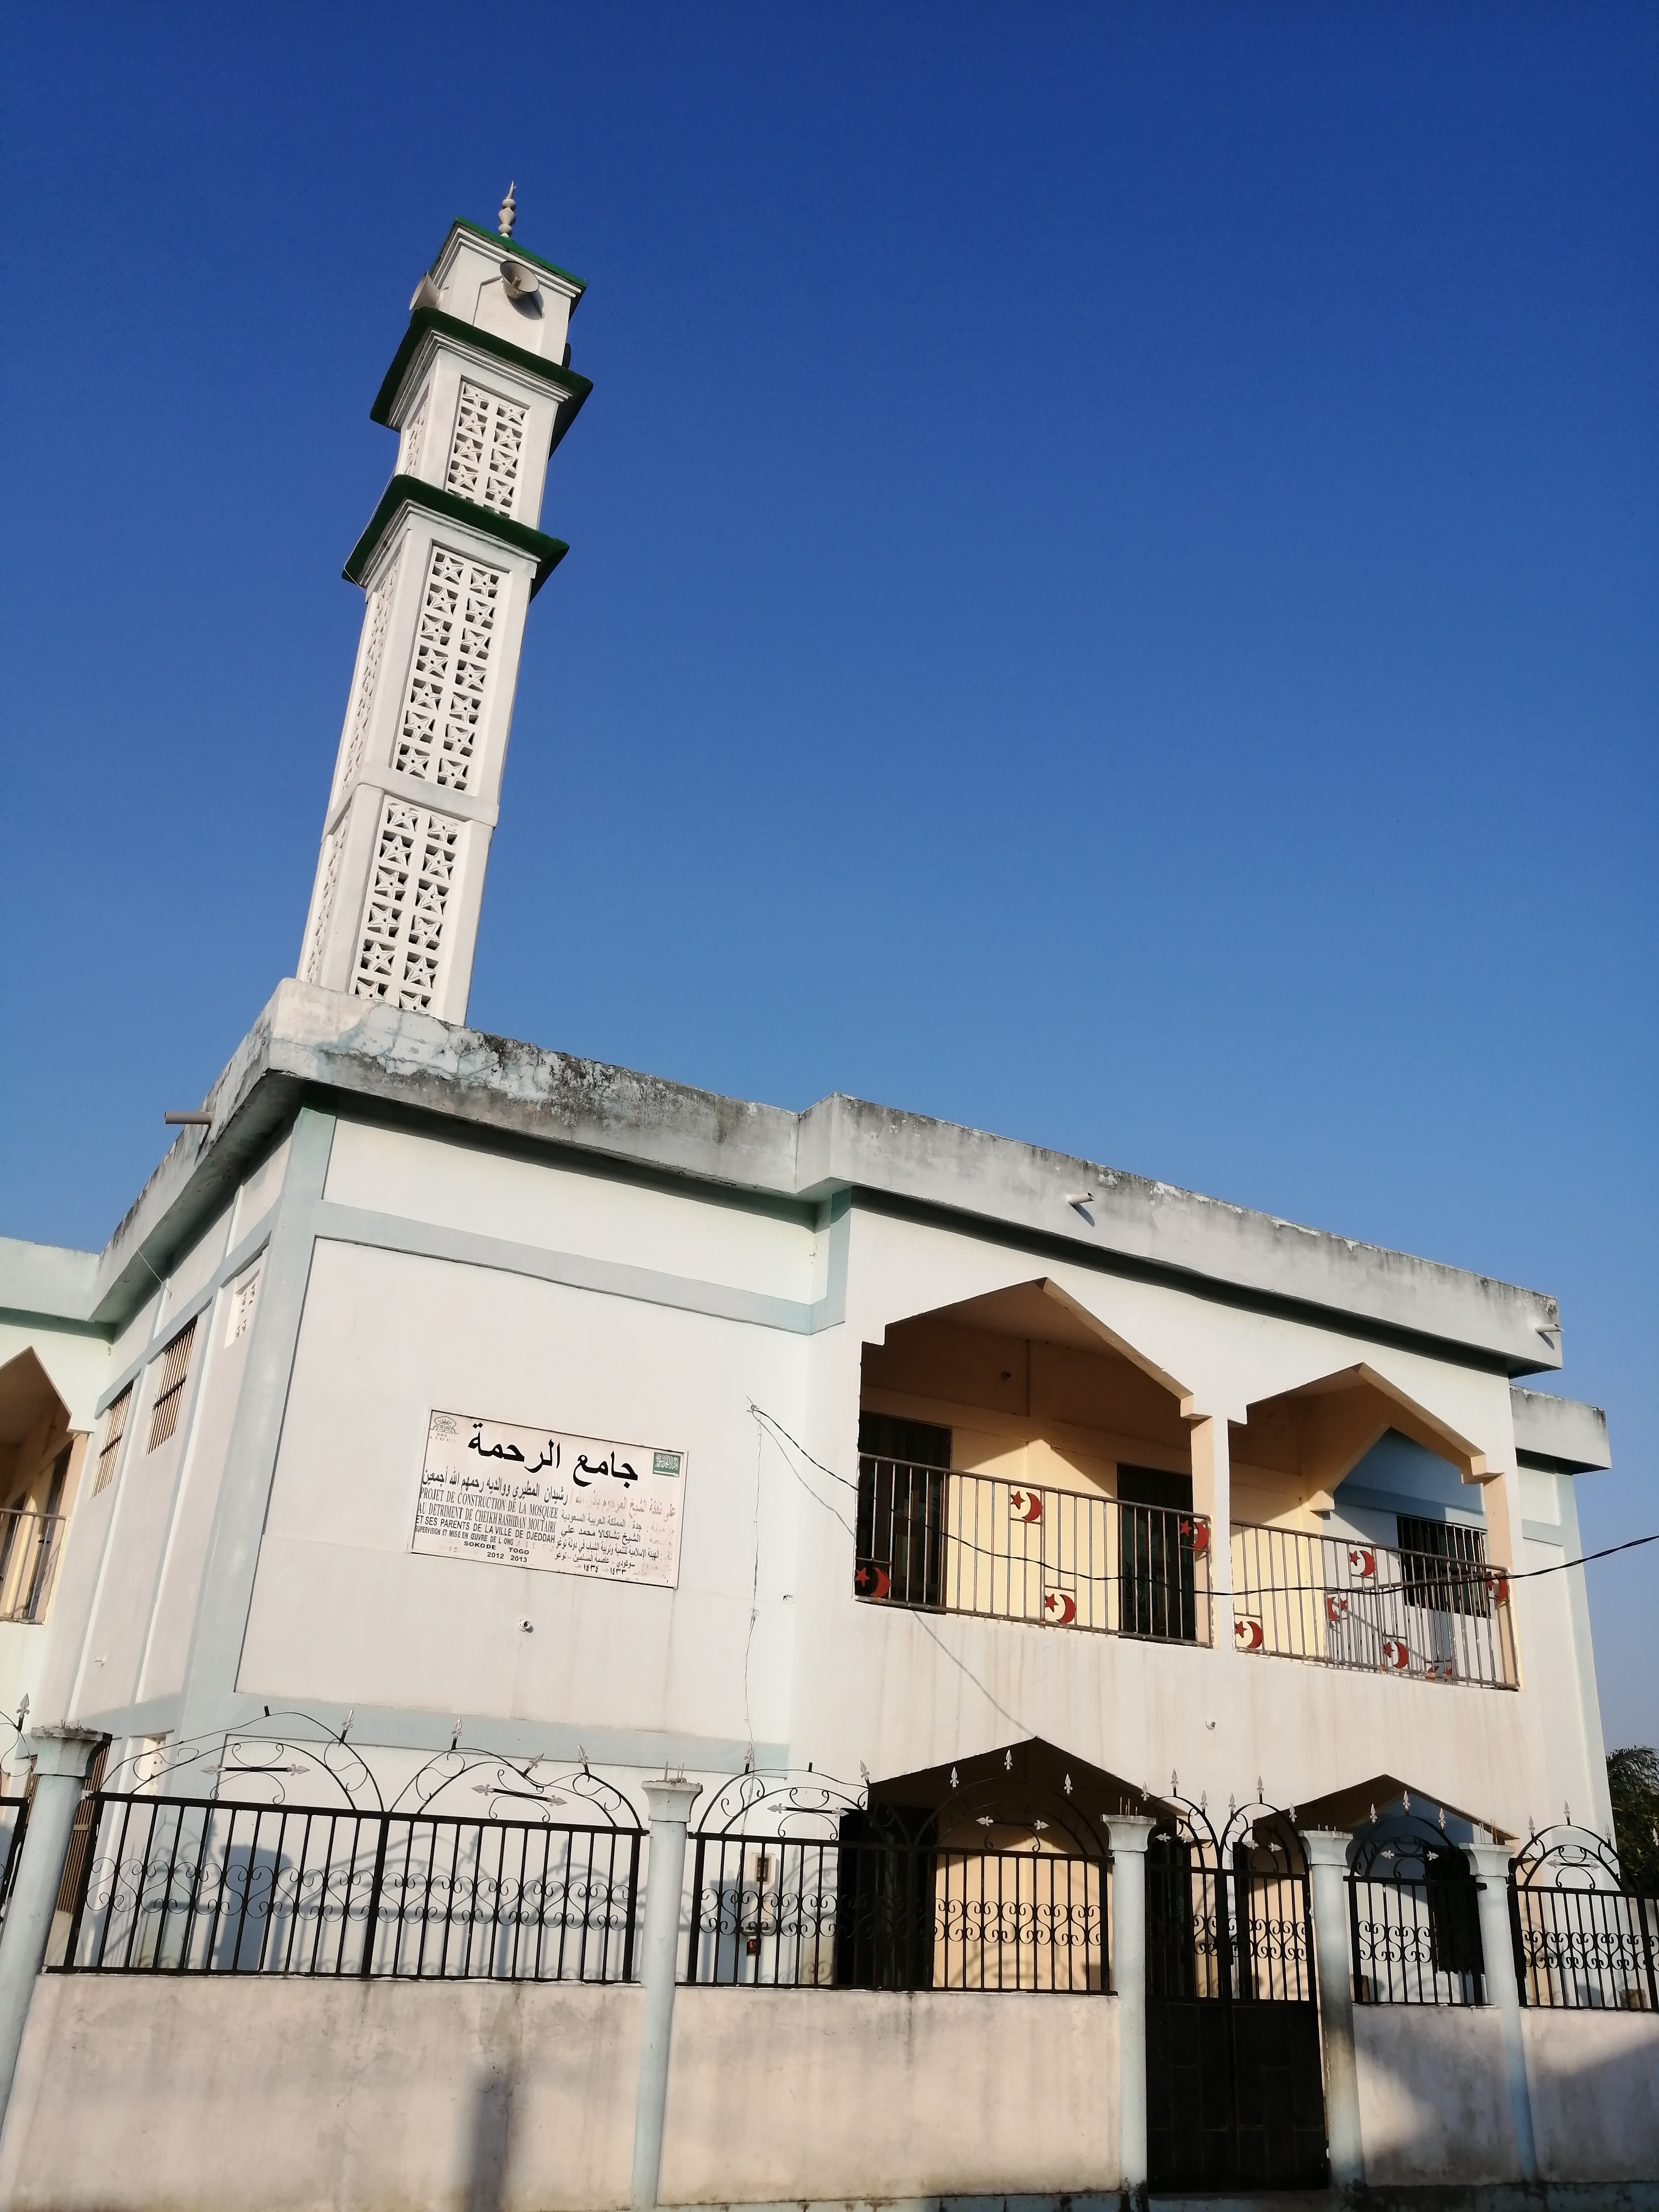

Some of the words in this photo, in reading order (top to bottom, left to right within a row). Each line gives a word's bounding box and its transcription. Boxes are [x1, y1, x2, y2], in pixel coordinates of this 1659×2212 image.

[467, 1422, 560, 1473] الرحمة
[422, 1466, 448, 1487] أجمعين
[449, 1466, 460, 1486] الله
[573, 1450, 639, 1489] جامع
[461, 1476, 484, 1493] رحمهم
[487, 1475, 511, 1497] ووالديه
[512, 1480, 540, 1500] المطيري
[544, 1486, 568, 1506] رشيدان
[420, 1487, 444, 1502] PROJET
[447, 1491, 456, 1503] DE
[458, 1492, 507, 1511] CONSTRUCTION
[507, 1500, 516, 1512] DE
[519, 1502, 527, 1514] LA
[529, 1503, 558, 1520] MOSQUEE
[629, 1498, 647, 1519] الشيخ
[418, 1502, 427, 1514] AU
[428, 1503, 463, 1519] DETRIMENT
[465, 1508, 473, 1521] DE
[475, 1509, 498, 1525] CHEIKH
[498, 1513, 527, 1529] RASHIDAN
[527, 1518, 556, 1533] MOUTAIRI
[561, 1509, 585, 1523] السعودية
[587, 1513, 606, 1526] العربية
[607, 1514, 626, 1528] المملكة
[415, 1514, 424, 1524] ET
[425, 1516, 438, 1526] SES
[440, 1518, 470, 1530] PARENTS
[473, 1523, 482, 1532] DE
[485, 1525, 493, 1534] LA
[495, 1526, 512, 1536] VILLE
[515, 1529, 524, 1538] DE
[526, 1531, 555, 1544] DJEDDAH
[561, 1524, 575, 1537] علي
[579, 1528, 595, 1536] محمد
[632, 1520, 642, 1532] جدة
[414, 1525, 441, 1535] SUPERVISION
[449, 1529, 461, 1538] MISE
[504, 1537, 514, 1545] ONG
[622, 1532, 641, 1545] الشيخ
[463, 1540, 496, 1550] SOKODE
[555, 1537, 567, 1549] توغو
[568, 1537, 577, 1551] دولة
[579, 1539, 585, 1554] في
[555, 1551, 567, 1561] توغو
[573, 1553, 593, 1562] المسلمين
[595, 1553, 610, 1563] عاصمة
[583, 1564, 599, 1573] ١٤٣٤
[610, 1567, 626, 1575] ١٤٣٣
